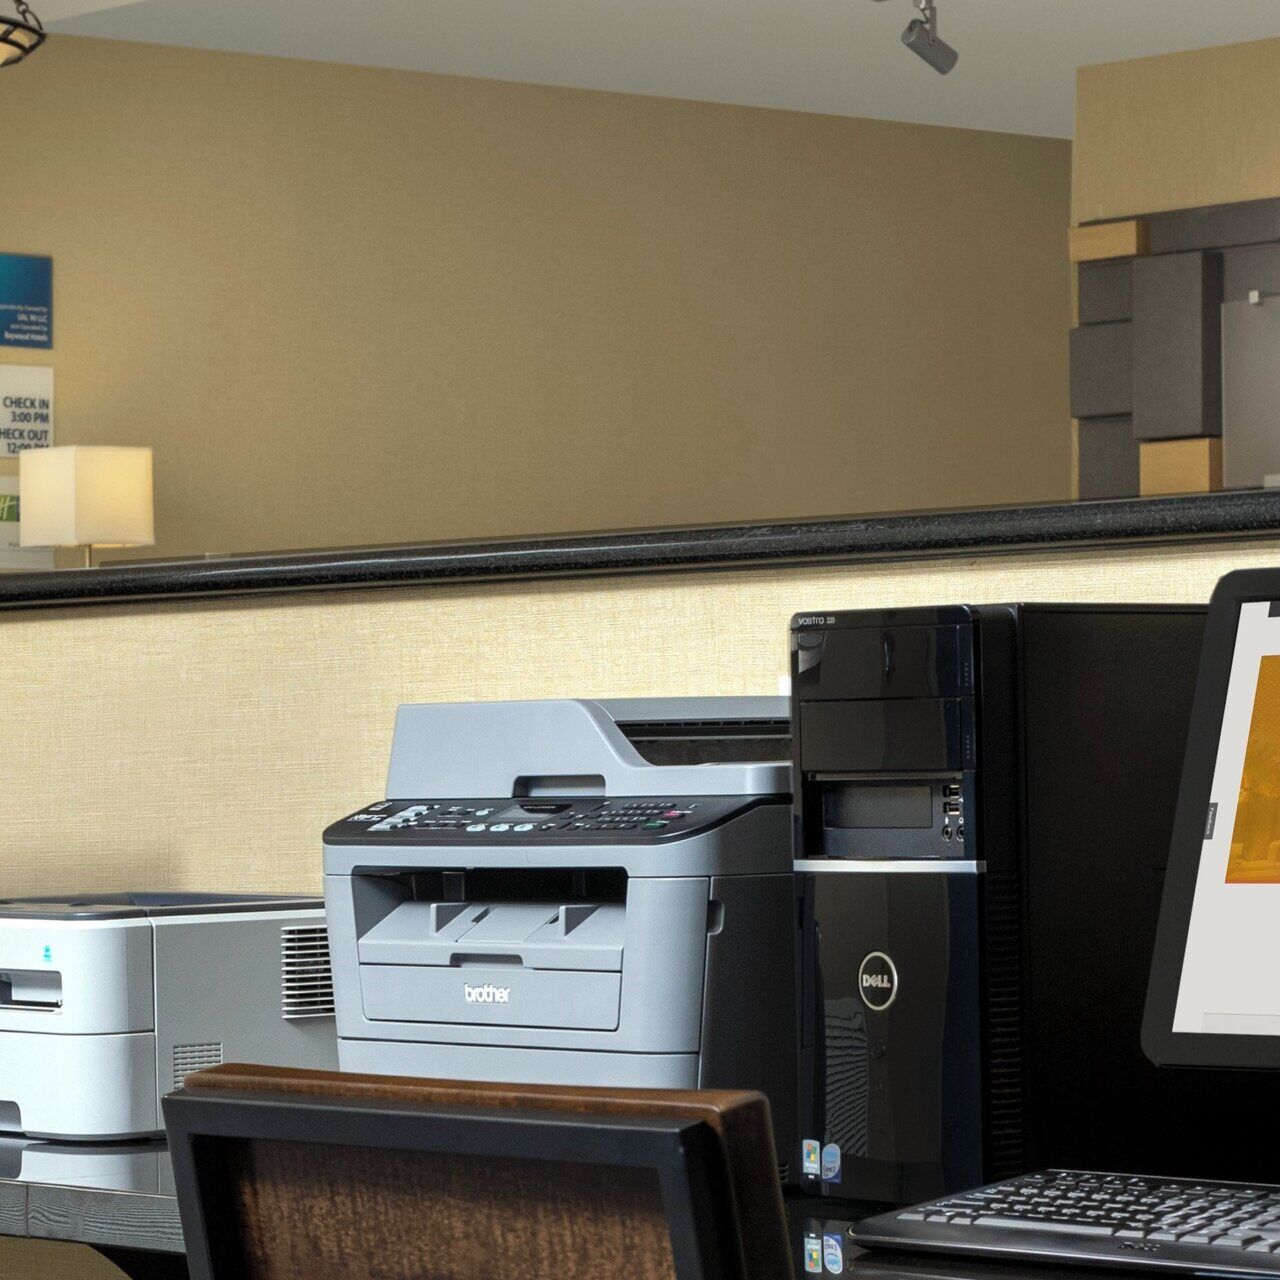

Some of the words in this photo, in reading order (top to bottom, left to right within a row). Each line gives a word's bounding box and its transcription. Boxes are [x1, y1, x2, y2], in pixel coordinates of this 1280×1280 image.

[3, 396, 37, 409] CHECK
[38, 399, 49, 410] IN
[11, 411, 32, 423] 3:00
[33, 412, 49, 424] PM
[27, 429, 49, 441] OUT
[862, 974, 891, 988] DELL
[464, 983, 511, 1003] brother
